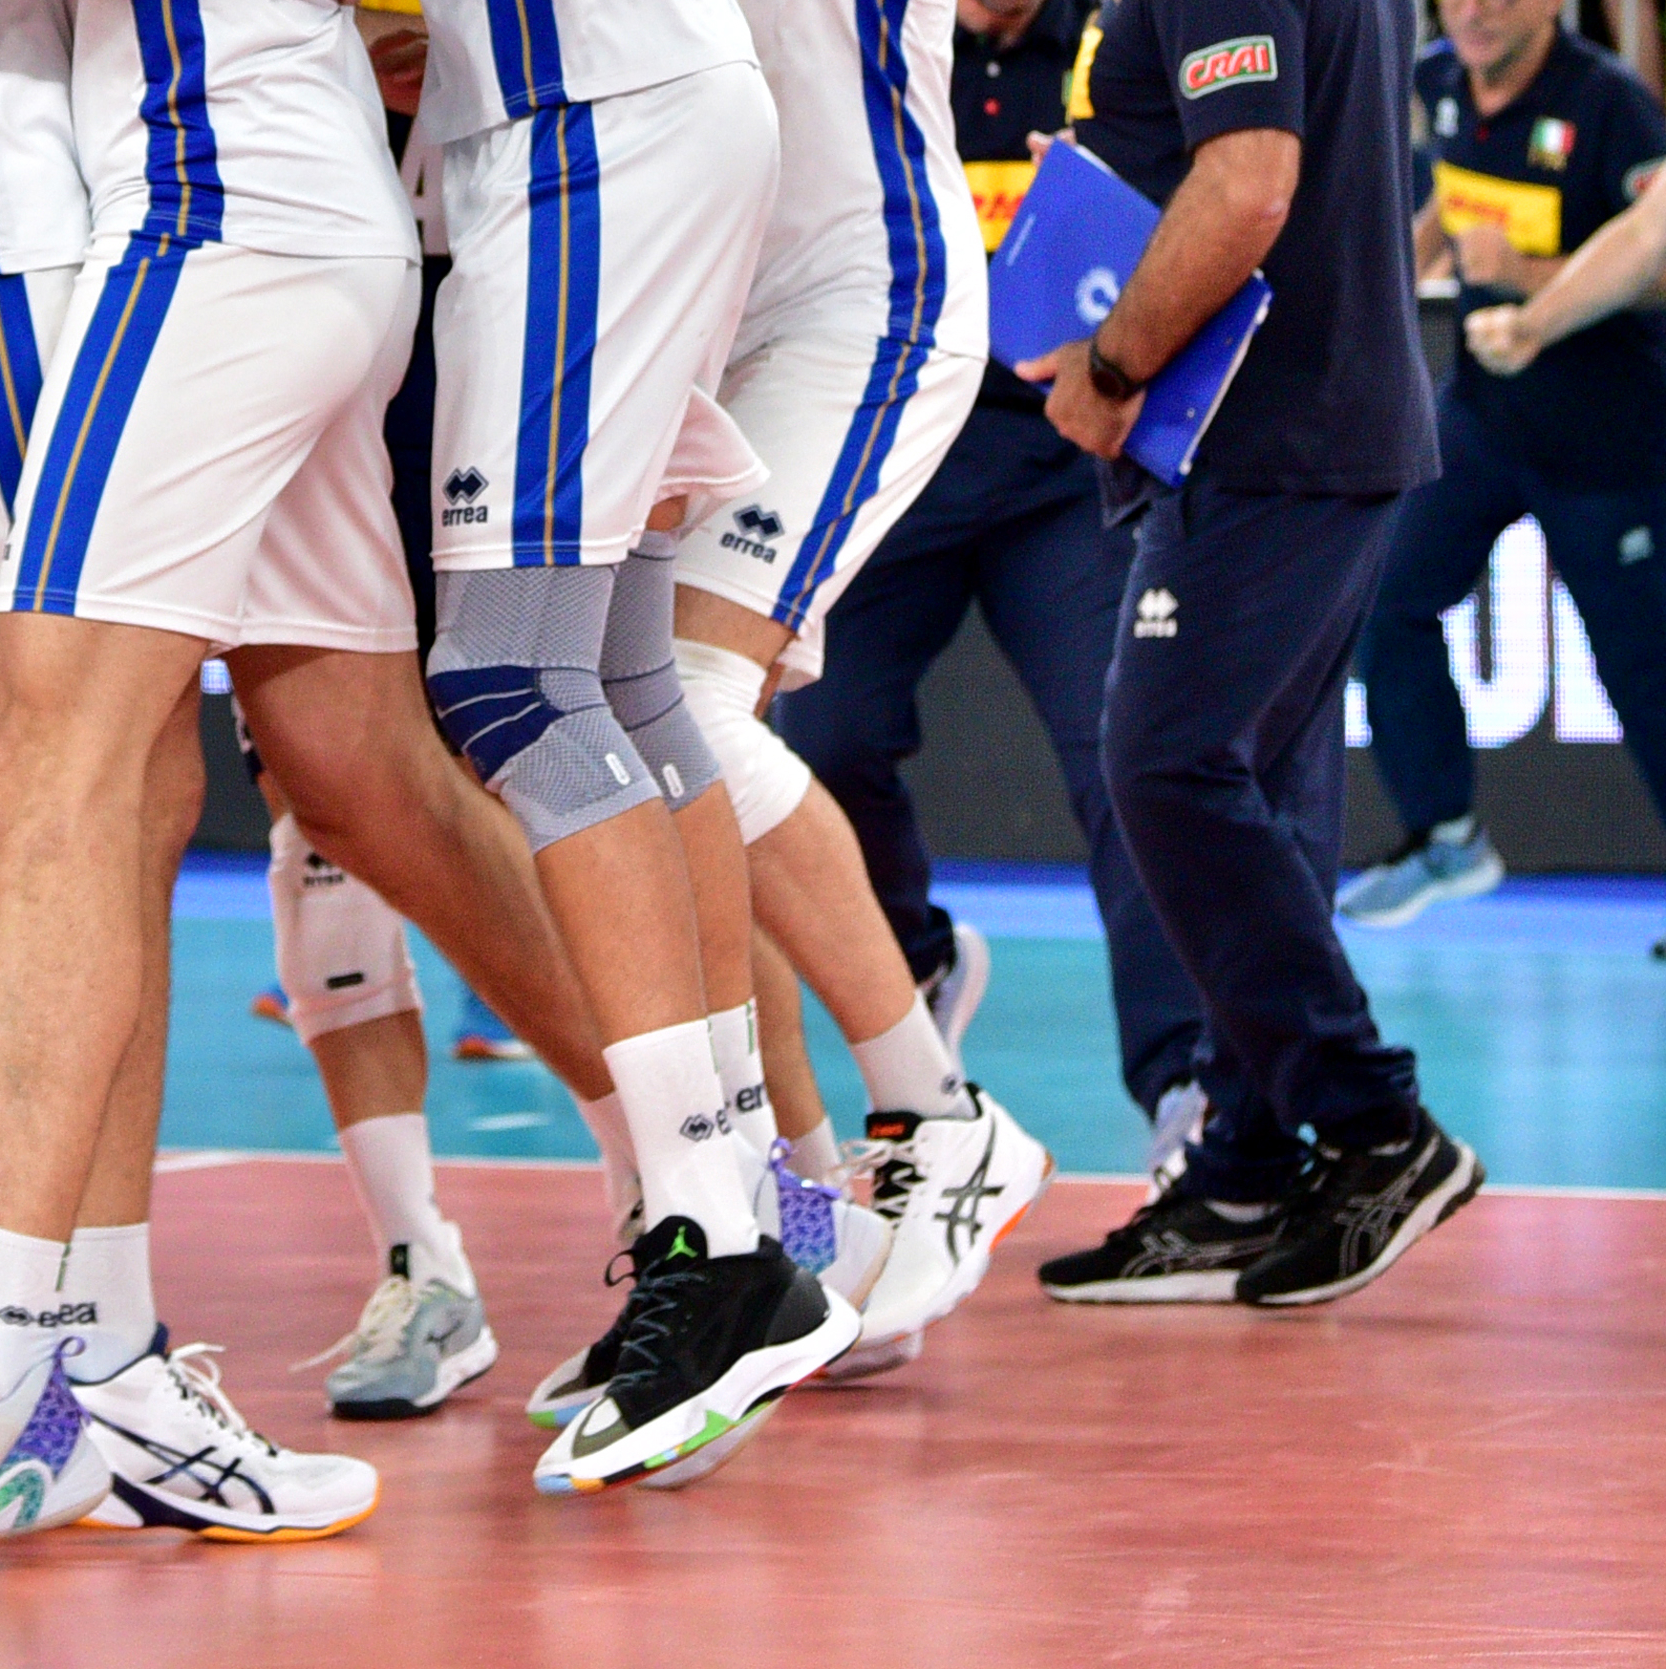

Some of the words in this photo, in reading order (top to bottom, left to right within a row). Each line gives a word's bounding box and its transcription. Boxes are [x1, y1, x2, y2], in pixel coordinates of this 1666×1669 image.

[1185, 44, 1271, 90] CRAI
[441, 504, 489, 528] errea
[719, 531, 778, 565] errea
